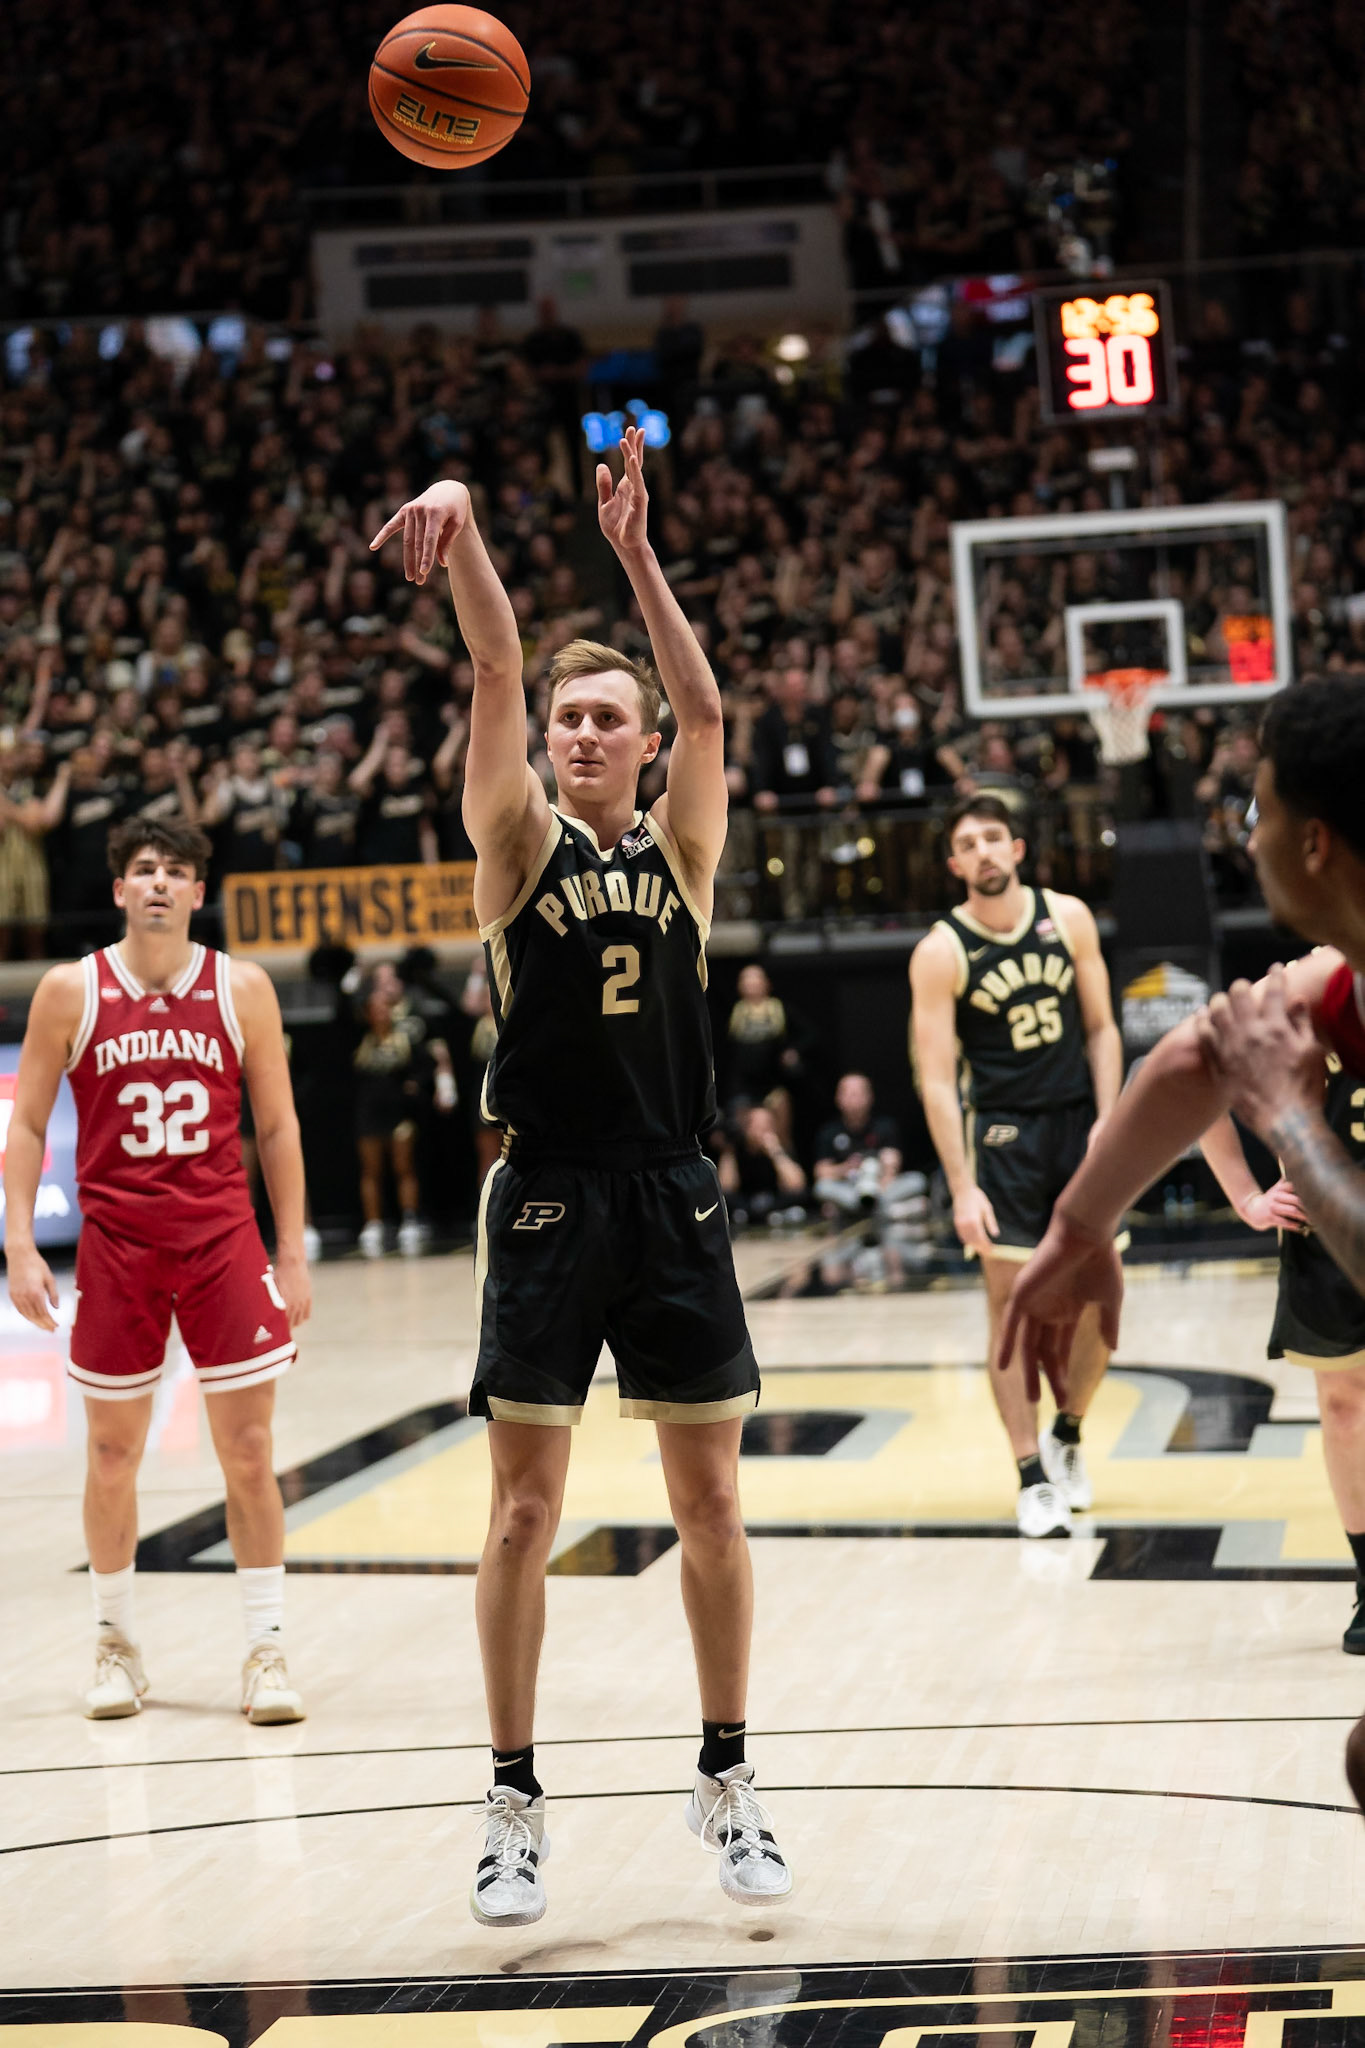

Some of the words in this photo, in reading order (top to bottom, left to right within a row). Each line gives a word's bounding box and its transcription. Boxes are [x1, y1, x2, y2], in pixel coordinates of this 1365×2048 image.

[396, 92, 481, 139] ELITE
[1064, 335, 1155, 409] 30
[235, 877, 418, 943] DEFENSE
[535, 869, 681, 937] PURDUE
[602, 944, 641, 1015] 2
[969, 952, 1074, 1015] PURDUE
[94, 1028, 225, 1076] INDIANA
[1006, 995, 1063, 1052] 25
[117, 1079, 211, 1158] 32
